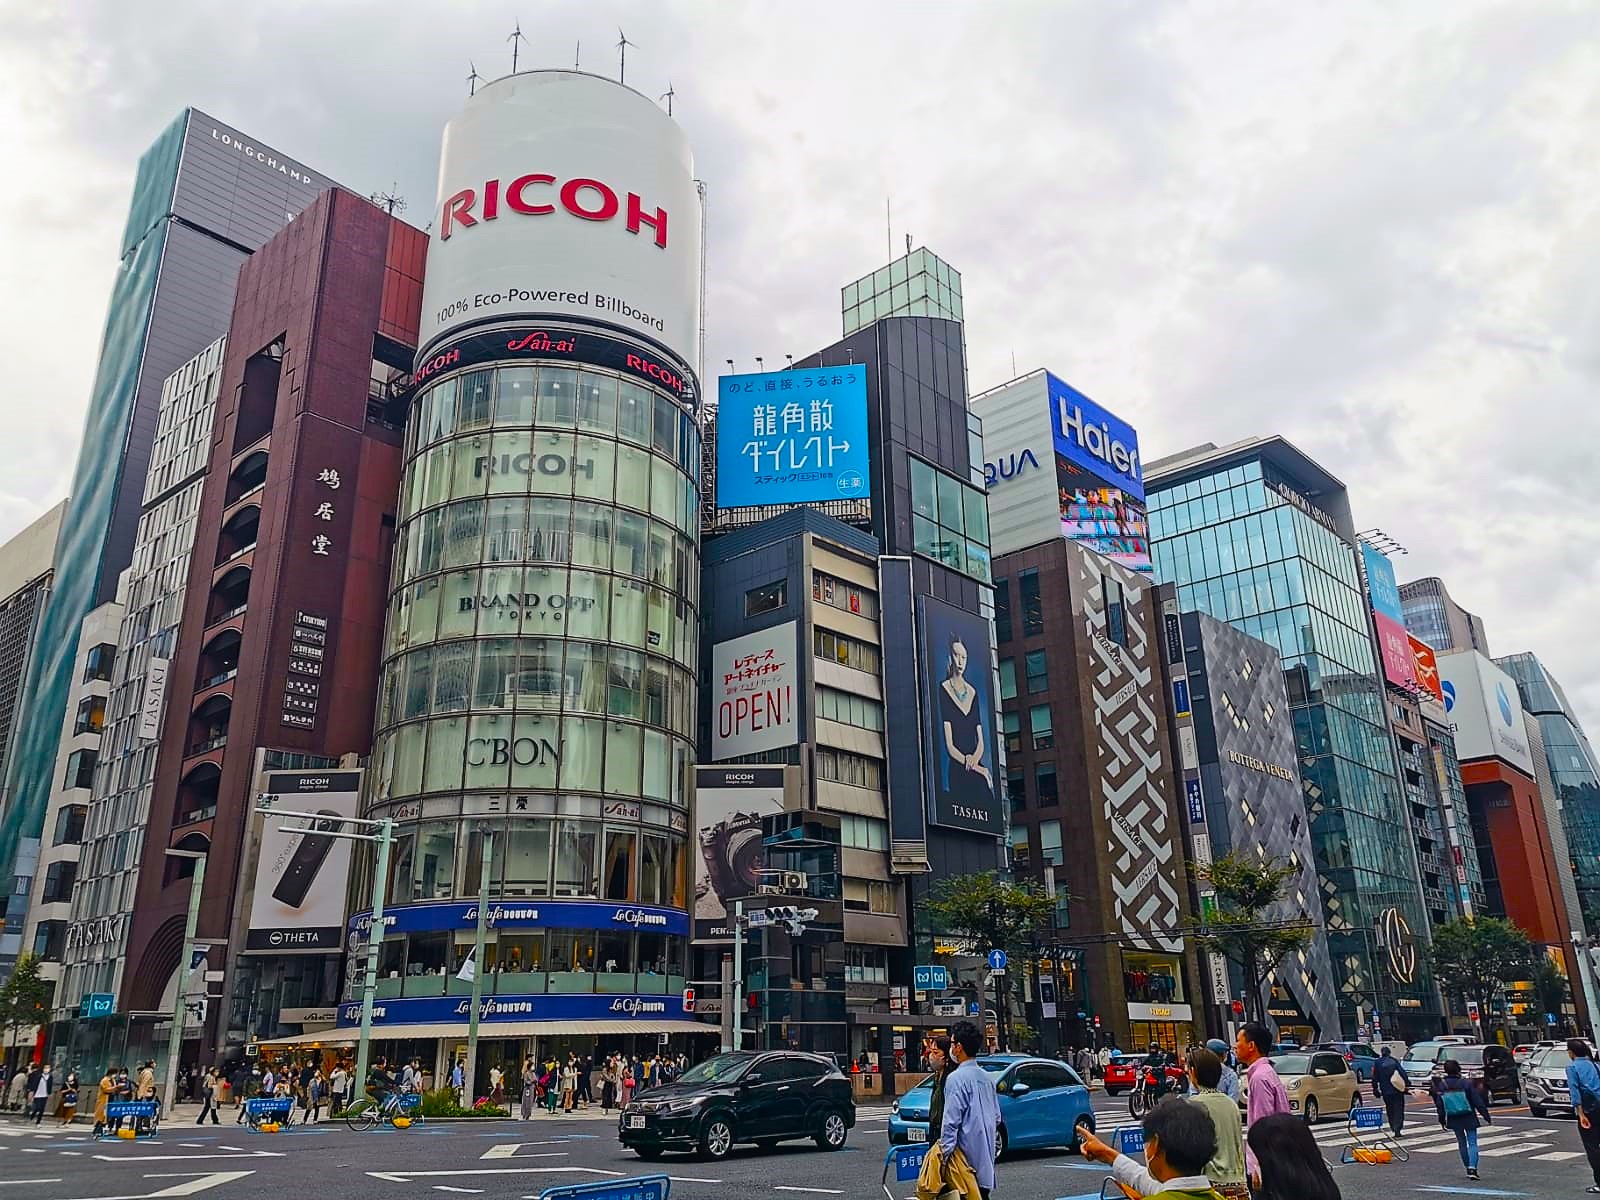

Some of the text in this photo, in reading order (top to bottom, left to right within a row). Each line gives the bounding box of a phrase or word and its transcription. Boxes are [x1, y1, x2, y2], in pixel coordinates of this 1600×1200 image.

[212, 128, 312, 186] LONGCHAMP
[440, 173, 668, 249] RICOH
[435, 288, 665, 332] 100% Eco-Powered Billboard
[626, 352, 685, 393] RICOH
[752, 398, 834, 437] 龍角散
[741, 434, 851, 474] ダイレクト
[1059, 395, 1138, 480] Haier
[473, 452, 595, 479] RICOH
[311, 467, 341, 556] 鳩居堂
[459, 593, 596, 612] BRAND OFF
[498, 610, 563, 621] TOKYO
[723, 661, 786, 686] アートネイチャー
[733, 648, 775, 670] レディース
[143, 667, 165, 730] TASAKI
[718, 685, 792, 739] OPEN!
[299, 777, 330, 786] RICOH
[1228, 750, 1294, 783] BOTTEGA VENETA
[952, 804, 989, 822] TASAKI
[1113, 811, 1145, 848] VERSACE
[612, 909, 625, 920] Le
[66, 916, 126, 952] TASAKI
[284, 932, 319, 943] THETA
[609, 998, 623, 1011] Le
